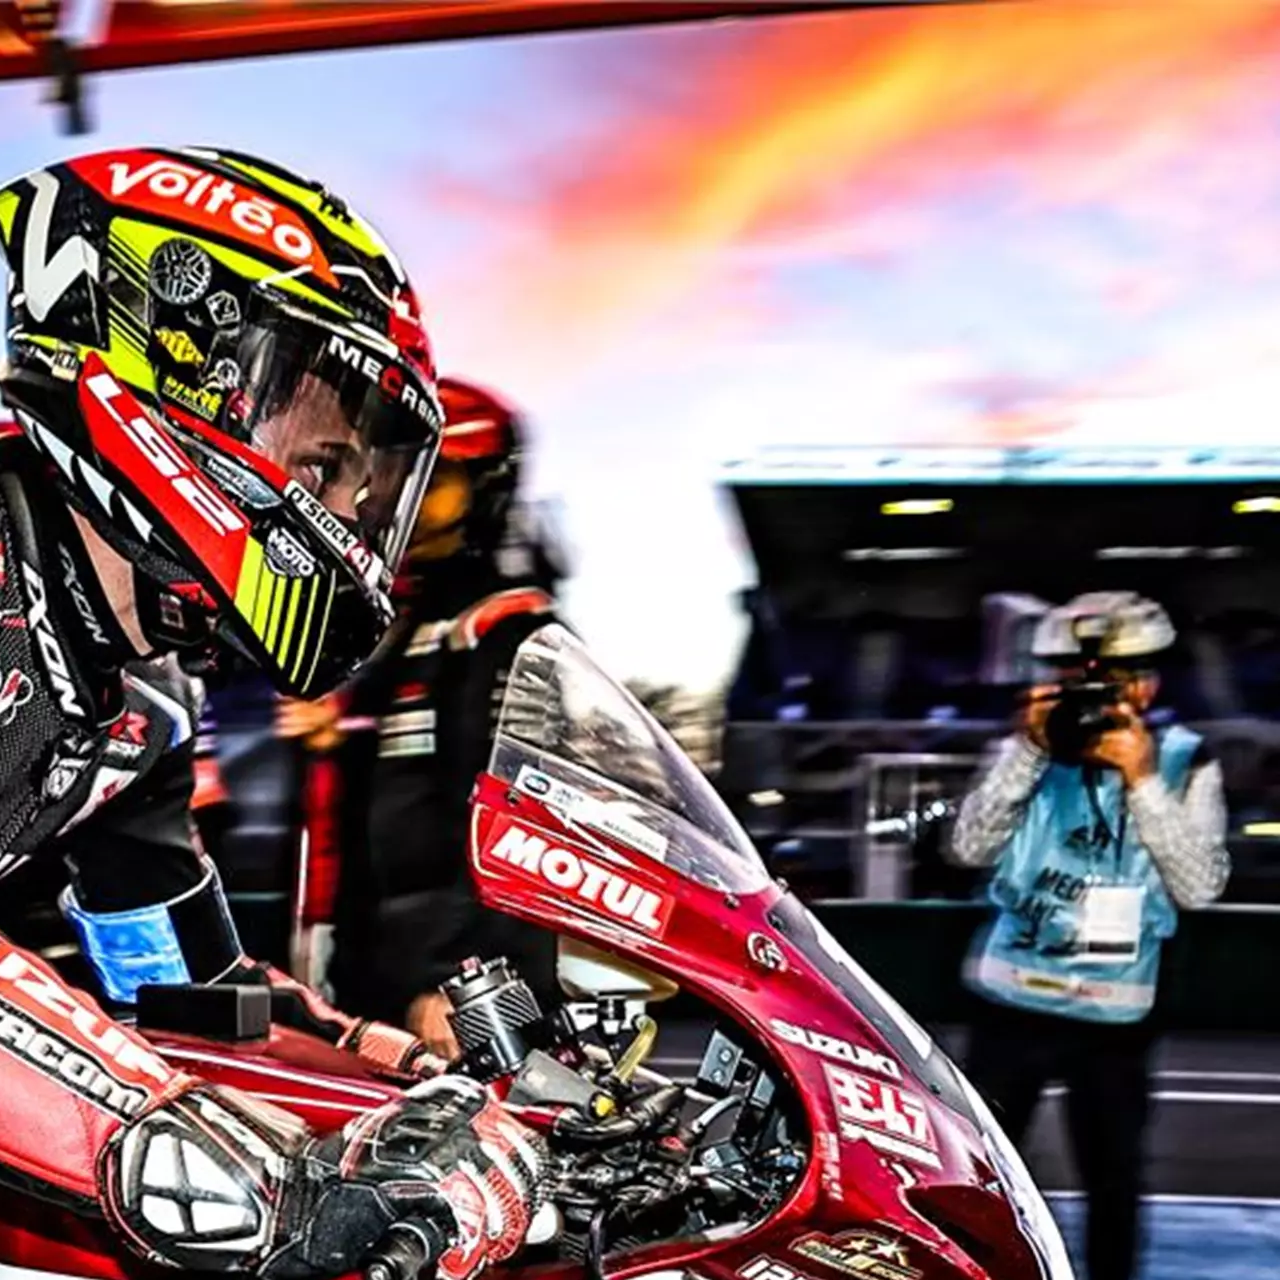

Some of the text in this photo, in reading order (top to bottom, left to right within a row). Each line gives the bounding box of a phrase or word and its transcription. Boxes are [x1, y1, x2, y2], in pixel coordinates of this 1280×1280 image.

[86, 373, 244, 537] LS2
[491, 825, 664, 930] MOTUL
[769, 1017, 904, 1082] SUZUKI
